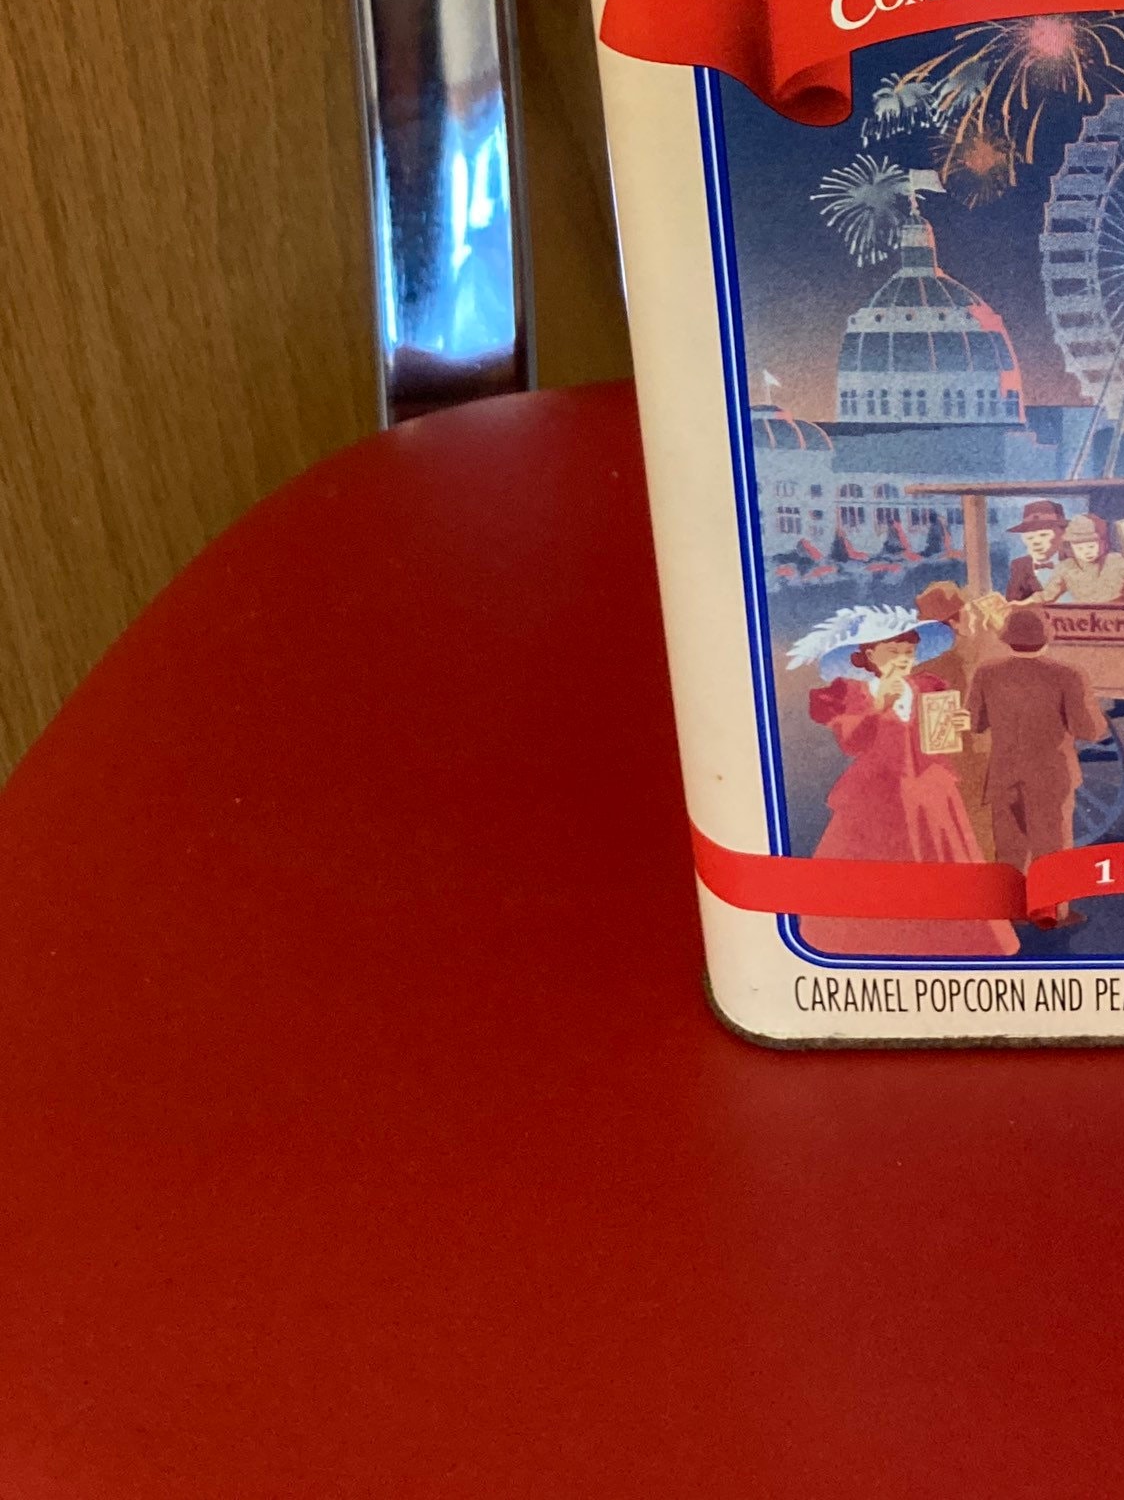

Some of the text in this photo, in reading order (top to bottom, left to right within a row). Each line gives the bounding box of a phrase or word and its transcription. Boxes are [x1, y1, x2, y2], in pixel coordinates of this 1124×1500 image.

[794, 975, 909, 1013] CARAMEL
[916, 977, 1026, 1013] POPCORN
[1035, 977, 1083, 1013] AND
